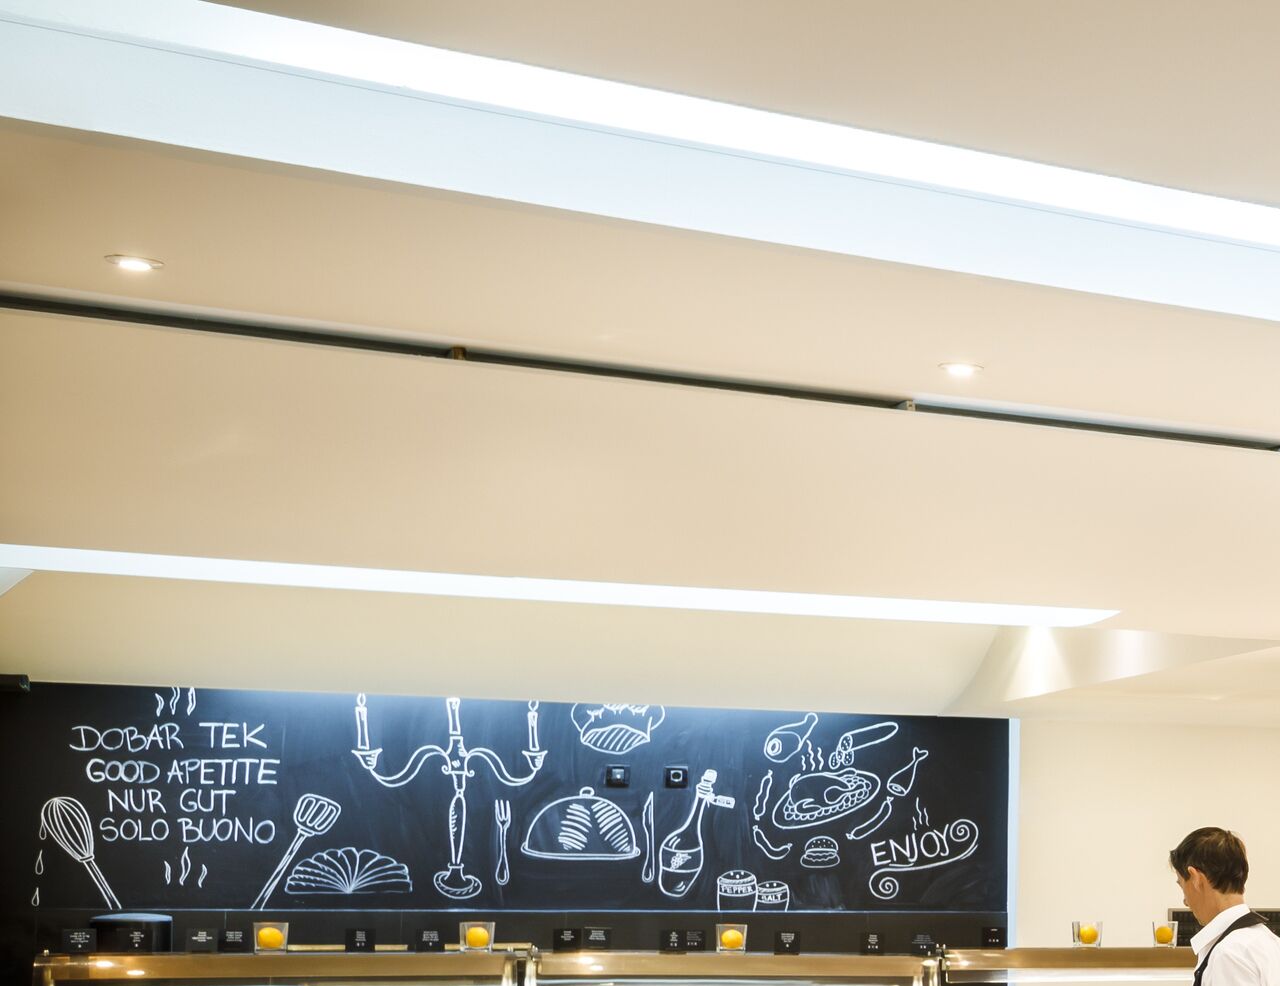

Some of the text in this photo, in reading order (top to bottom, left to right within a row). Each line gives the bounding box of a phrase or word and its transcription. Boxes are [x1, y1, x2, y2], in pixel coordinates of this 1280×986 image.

[69, 722, 267, 752] DOBAR TEK
[86, 758, 281, 785] GOOD APETITE
[107, 788, 236, 816] NUR GUT
[99, 816, 276, 845] SOLO BUONO
[870, 823, 950, 866] ENJOY
[720, 885, 754, 894] PEPPER
[761, 893, 782, 902] SALT
